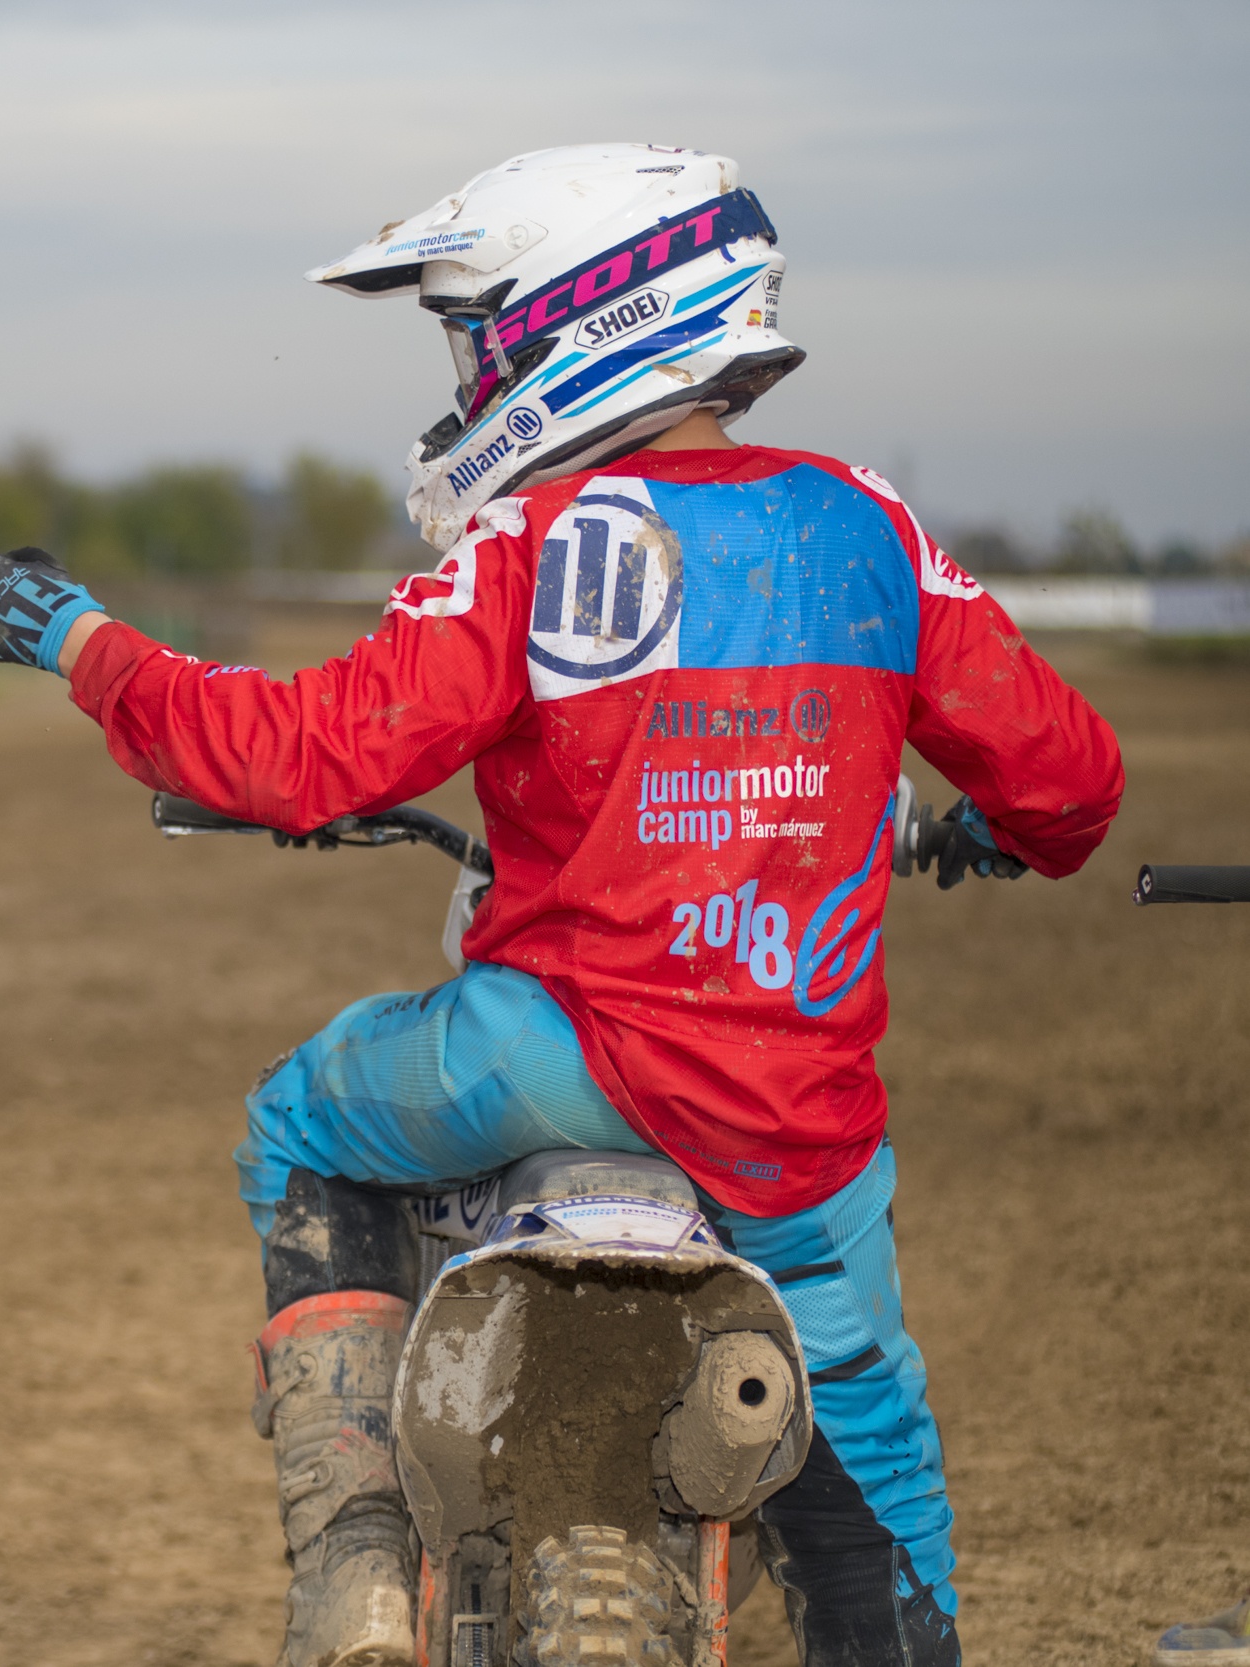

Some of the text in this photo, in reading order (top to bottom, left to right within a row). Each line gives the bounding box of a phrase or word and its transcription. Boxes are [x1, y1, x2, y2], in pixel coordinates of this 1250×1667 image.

[385, 228, 485, 256] juniormotorcamp
[418, 247, 426, 258] by
[427, 245, 444, 255] marc
[482, 206, 721, 365] SCOTT
[584, 292, 660, 345] SHOEI
[447, 434, 515, 498] Allianz
[646, 701, 781, 738] Allianz
[637, 754, 830, 811] juniormotor
[638, 810, 733, 850] camp
[740, 805, 759, 824] by
[741, 818, 825, 841] marc márquez
[669, 879, 794, 989] 2018
[741, 1164, 775, 1177] LXIII
